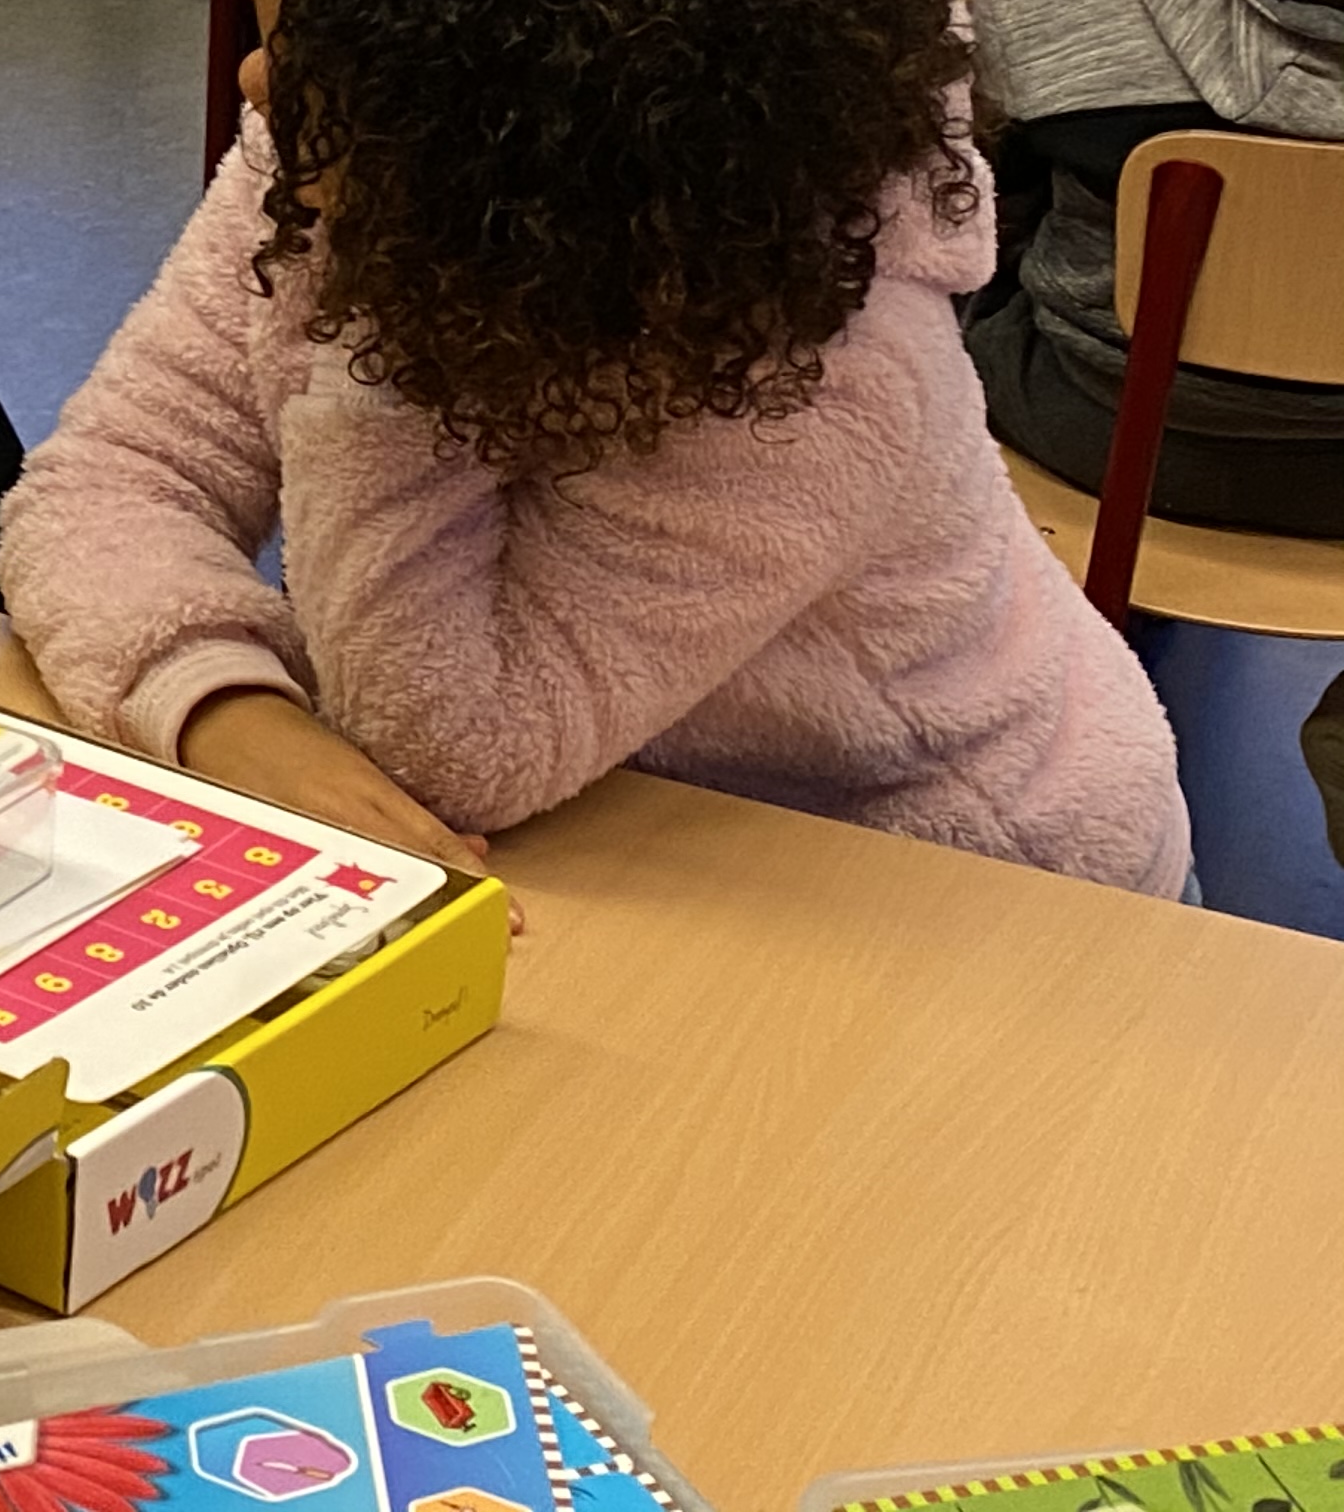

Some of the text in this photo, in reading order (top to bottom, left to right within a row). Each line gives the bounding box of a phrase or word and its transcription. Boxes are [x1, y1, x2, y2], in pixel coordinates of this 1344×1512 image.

[244, 846, 283, 867] 8
[192, 878, 234, 900] 3
[140, 908, 182, 930] 2
[84, 942, 125, 963] 8
